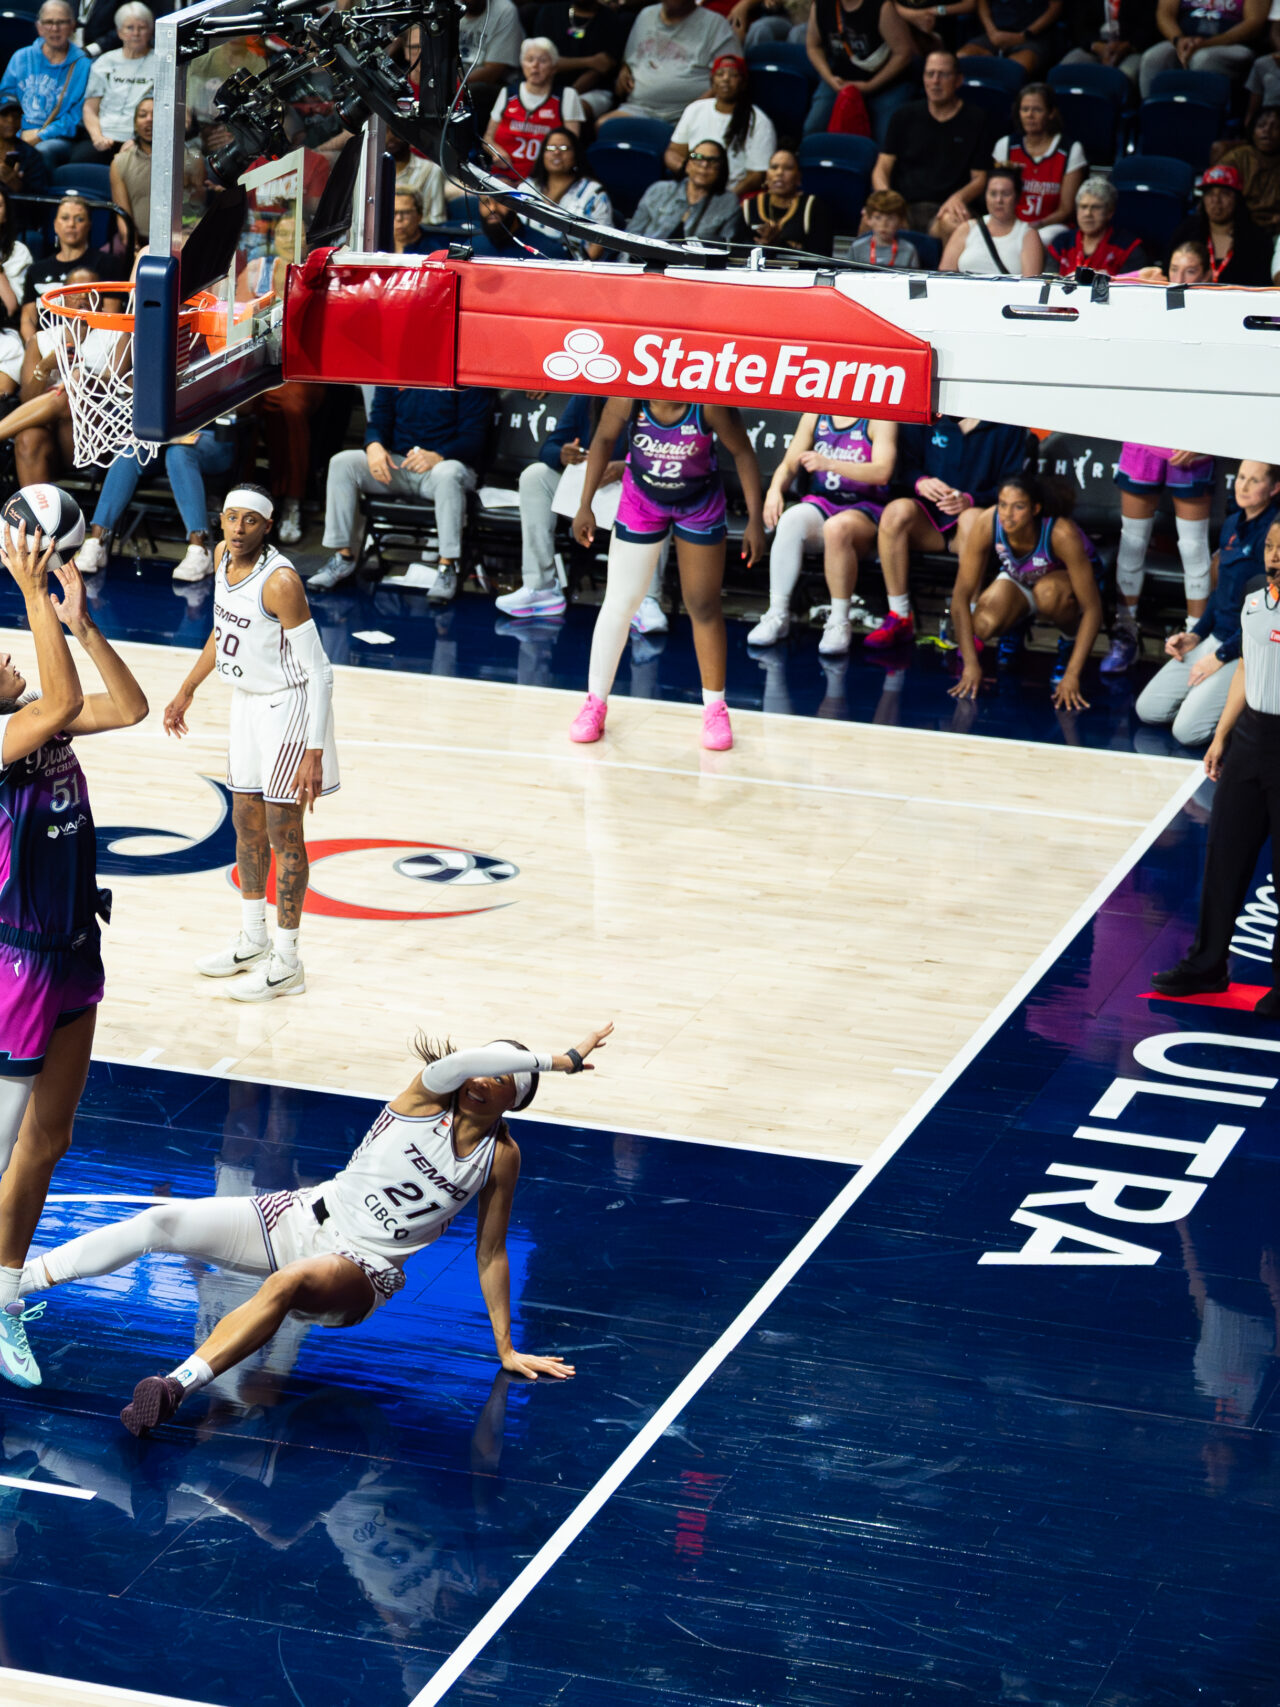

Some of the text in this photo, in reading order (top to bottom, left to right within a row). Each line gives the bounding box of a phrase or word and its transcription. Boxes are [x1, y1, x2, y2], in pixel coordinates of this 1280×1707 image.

[512, 136, 540, 161] 20
[633, 433, 699, 456] District
[647, 460, 683, 478] 12
[214, 602, 251, 629] EMPO
[45, 767, 56, 777] OF
[50, 773, 81, 812] 51
[977, 1031, 1280, 1266] ULTRA
[404, 1142, 469, 1202] TEMPO
[364, 1194, 398, 1231] CIBC
[382, 1181, 441, 1219] 21
